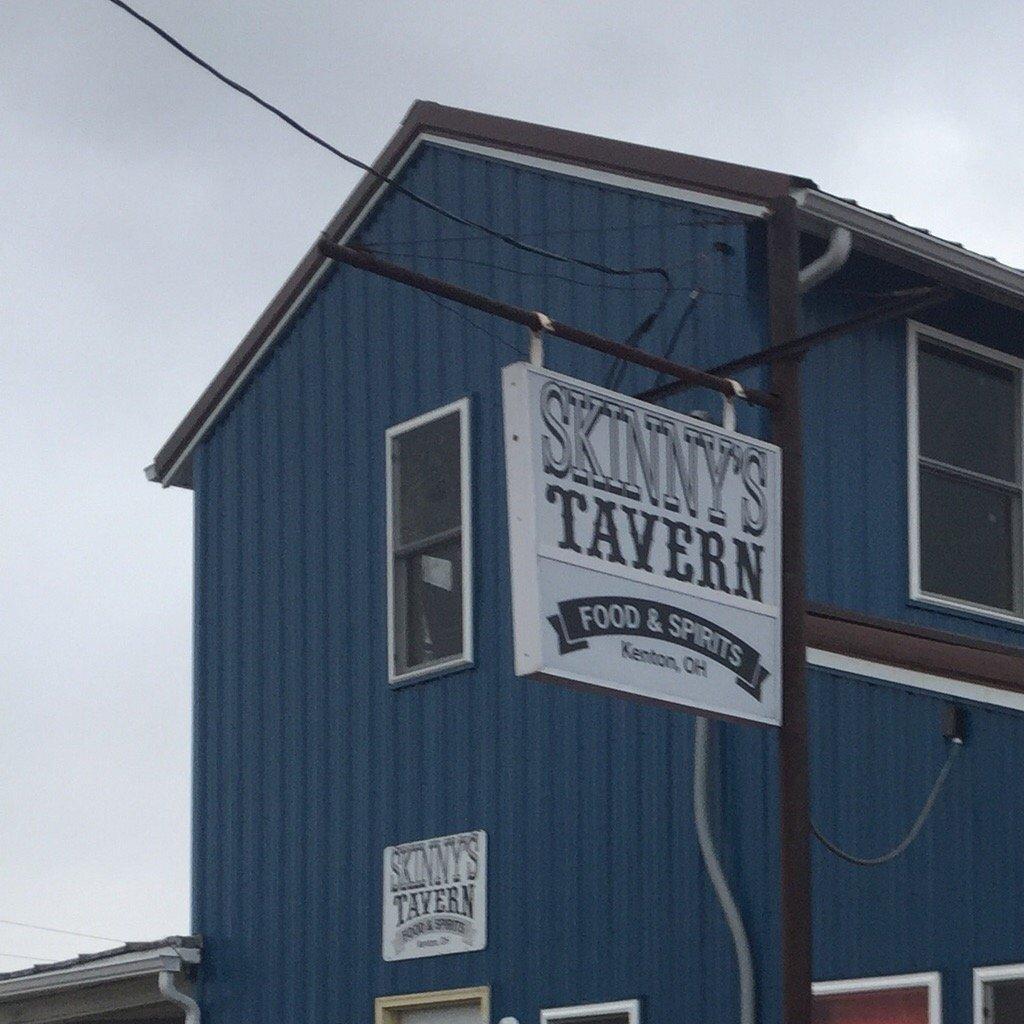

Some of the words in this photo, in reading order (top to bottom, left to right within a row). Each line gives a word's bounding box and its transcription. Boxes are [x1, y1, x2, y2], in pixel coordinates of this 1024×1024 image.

[539, 380, 768, 537] SKINNY'S
[545, 483, 764, 603] TAVERN
[578, 603, 641, 631] FOOD
[646, 608, 664, 634] &
[668, 613, 744, 668] SPIRITS
[621, 639, 681, 672] Kenton,
[683, 655, 708, 678] OH
[393, 884, 474, 927] TAVERN
